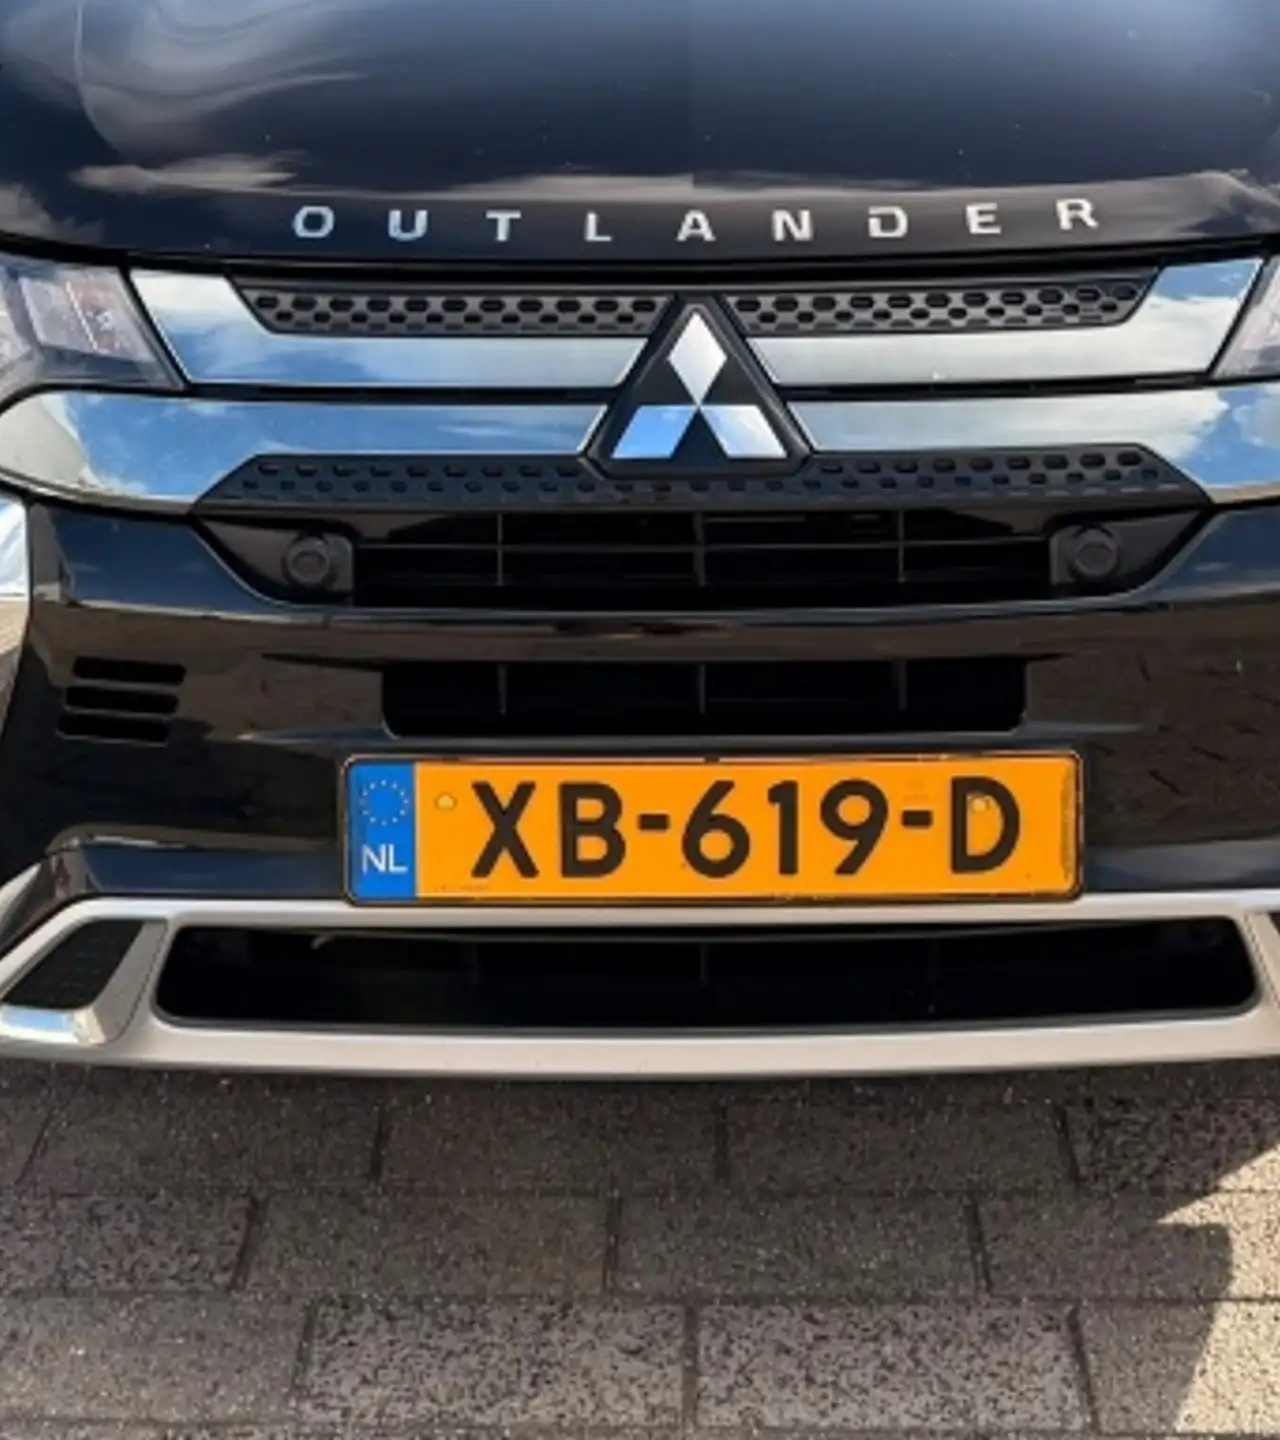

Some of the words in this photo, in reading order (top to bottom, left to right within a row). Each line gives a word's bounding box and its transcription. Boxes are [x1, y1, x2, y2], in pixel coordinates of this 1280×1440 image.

[292, 198, 1099, 244] OUTLANDER
[361, 843, 409, 874] NL
[471, 776, 1021, 879] XB-619-D
